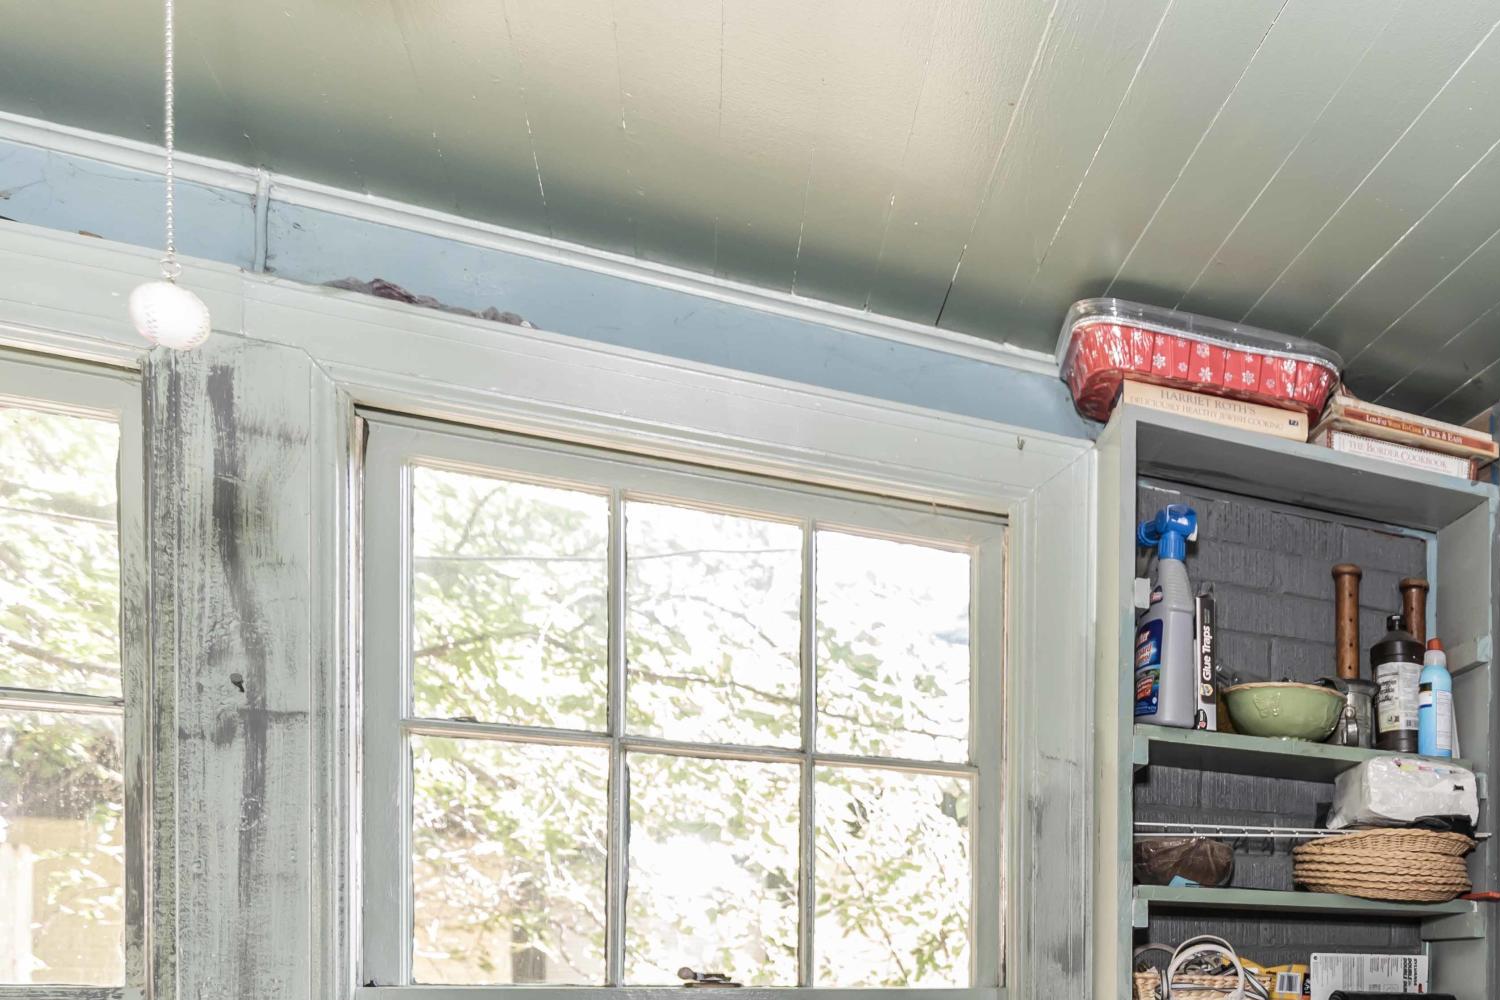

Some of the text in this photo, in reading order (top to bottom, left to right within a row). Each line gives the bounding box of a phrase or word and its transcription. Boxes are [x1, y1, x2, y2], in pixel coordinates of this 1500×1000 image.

[1160, 389, 1257, 415] HARRIET ROTH'S
[1202, 625, 1214, 655] Traps
[1202, 655, 1212, 682] Glue
